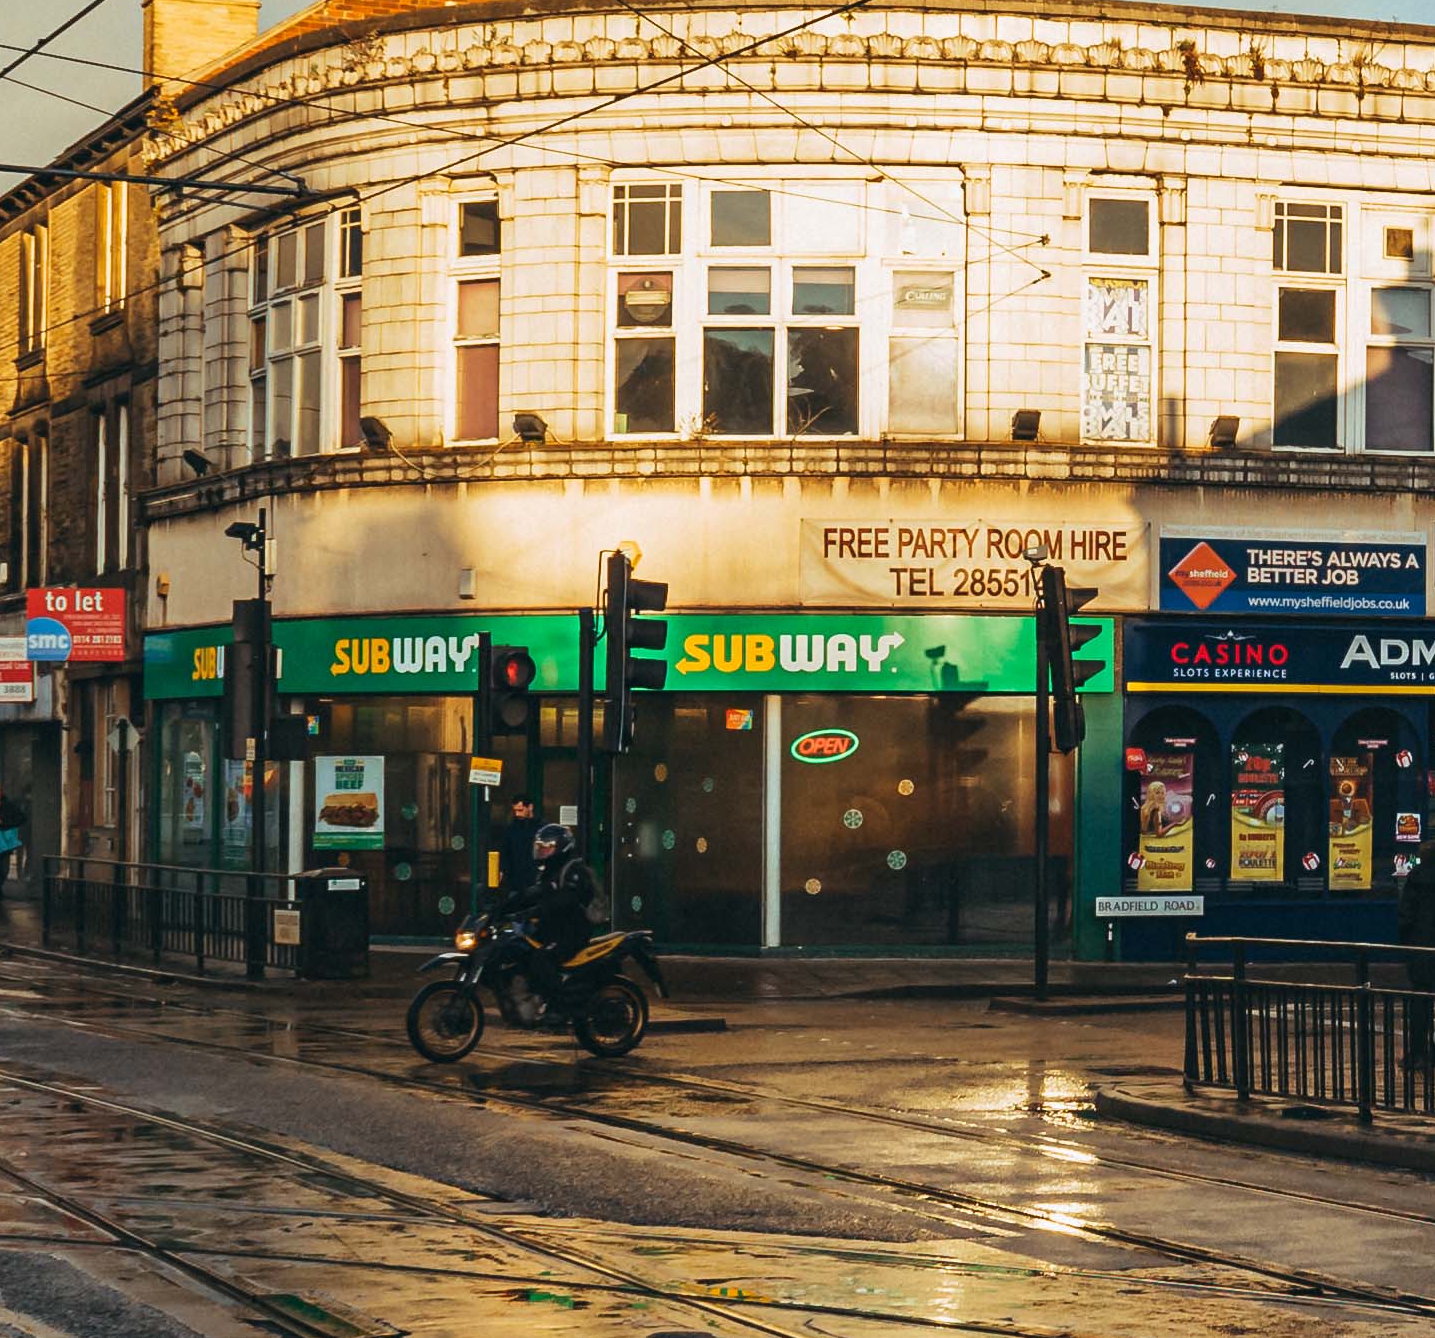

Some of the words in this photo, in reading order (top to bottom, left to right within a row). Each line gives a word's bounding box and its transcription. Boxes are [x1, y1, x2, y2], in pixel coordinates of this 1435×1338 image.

[823, 527, 890, 558] FREE
[897, 528, 979, 559] PARTY
[986, 528, 1063, 560] ROOM
[1070, 530, 1127, 561] HIRE
[1246, 548, 1323, 567] THERE'S
[1326, 551, 1402, 569] ALWAYS
[1405, 553, 1420, 569] A
[889, 567, 945, 596] TEL
[1246, 567, 1318, 585] BETTER
[1320, 569, 1360, 586] JOB
[45, 591, 67, 612] to
[75, 590, 104, 612] let
[1248, 595, 1410, 612] www.mysheffieldjobs.co.uk
[28, 634, 68, 649] smc
[330, 632, 479, 677] SUBWAY
[675, 631, 905, 675] SUBWAY
[1170, 642, 1289, 666] CASINO
[1173, 668, 1210, 679] SLOTS
[1214, 668, 1287, 679] EXPERIENCE
[1390, 672, 1416, 681] SLOTS
[798, 736, 850, 756] OPEN
[335, 780, 364, 790] BEEF
[1098, 900, 1159, 912] BRADFIELD
[1164, 900, 1195, 911] ROAD
